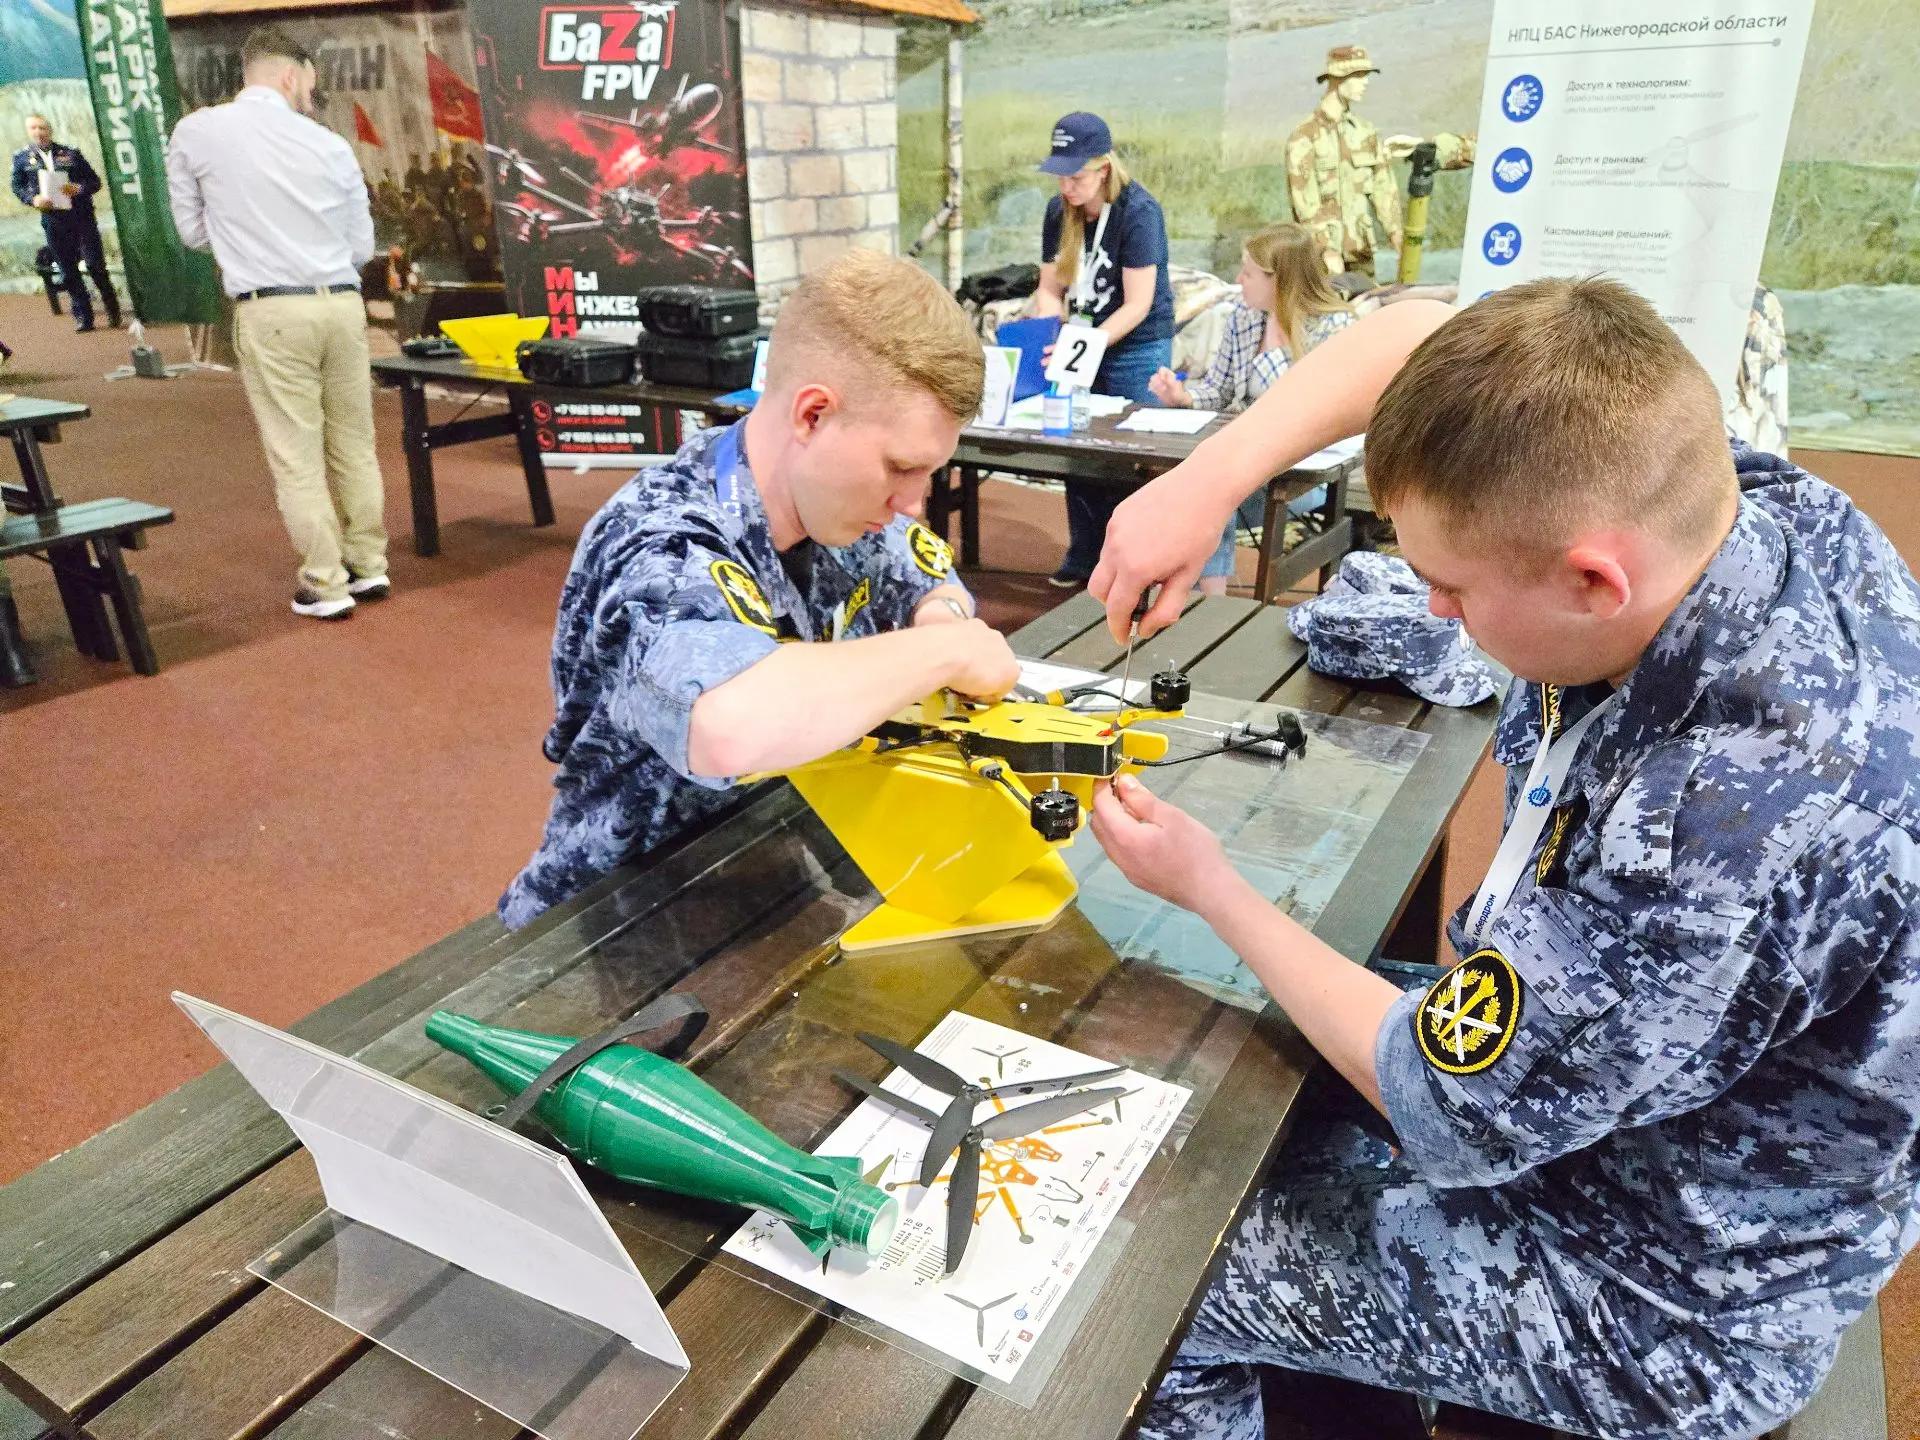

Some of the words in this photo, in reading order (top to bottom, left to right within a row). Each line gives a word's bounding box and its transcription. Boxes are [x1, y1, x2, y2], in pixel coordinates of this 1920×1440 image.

[1507, 27, 1540, 43] НПЦ
[1544, 25, 1578, 41] БАС
[1580, 16, 1709, 38] Нижегородской
[1714, 14, 1788, 31] области
[113, 3, 152, 112] АРК
[581, 64, 660, 100] FPV
[1565, 80, 1604, 93] Доступ
[1615, 79, 1692, 90] технологиям:
[88, 0, 143, 201] АТРИОТ
[1554, 154, 1593, 165] Доступ
[1543, 225, 1614, 238] Кастомизация
[1616, 229, 1673, 240] решений:
[547, 291, 640, 316] ИНЖЕ
[1064, 339, 1087, 373] 2
[1473, 893, 1496, 938] Кибердром
[1082, 1159, 1092, 1168] 10
[903, 1217, 914, 1227] 15
[912, 1221, 923, 1231] 16
[923, 1226, 934, 1236] 17
[880, 1261, 890, 1272] 13
[914, 1277, 925, 1287] 14
